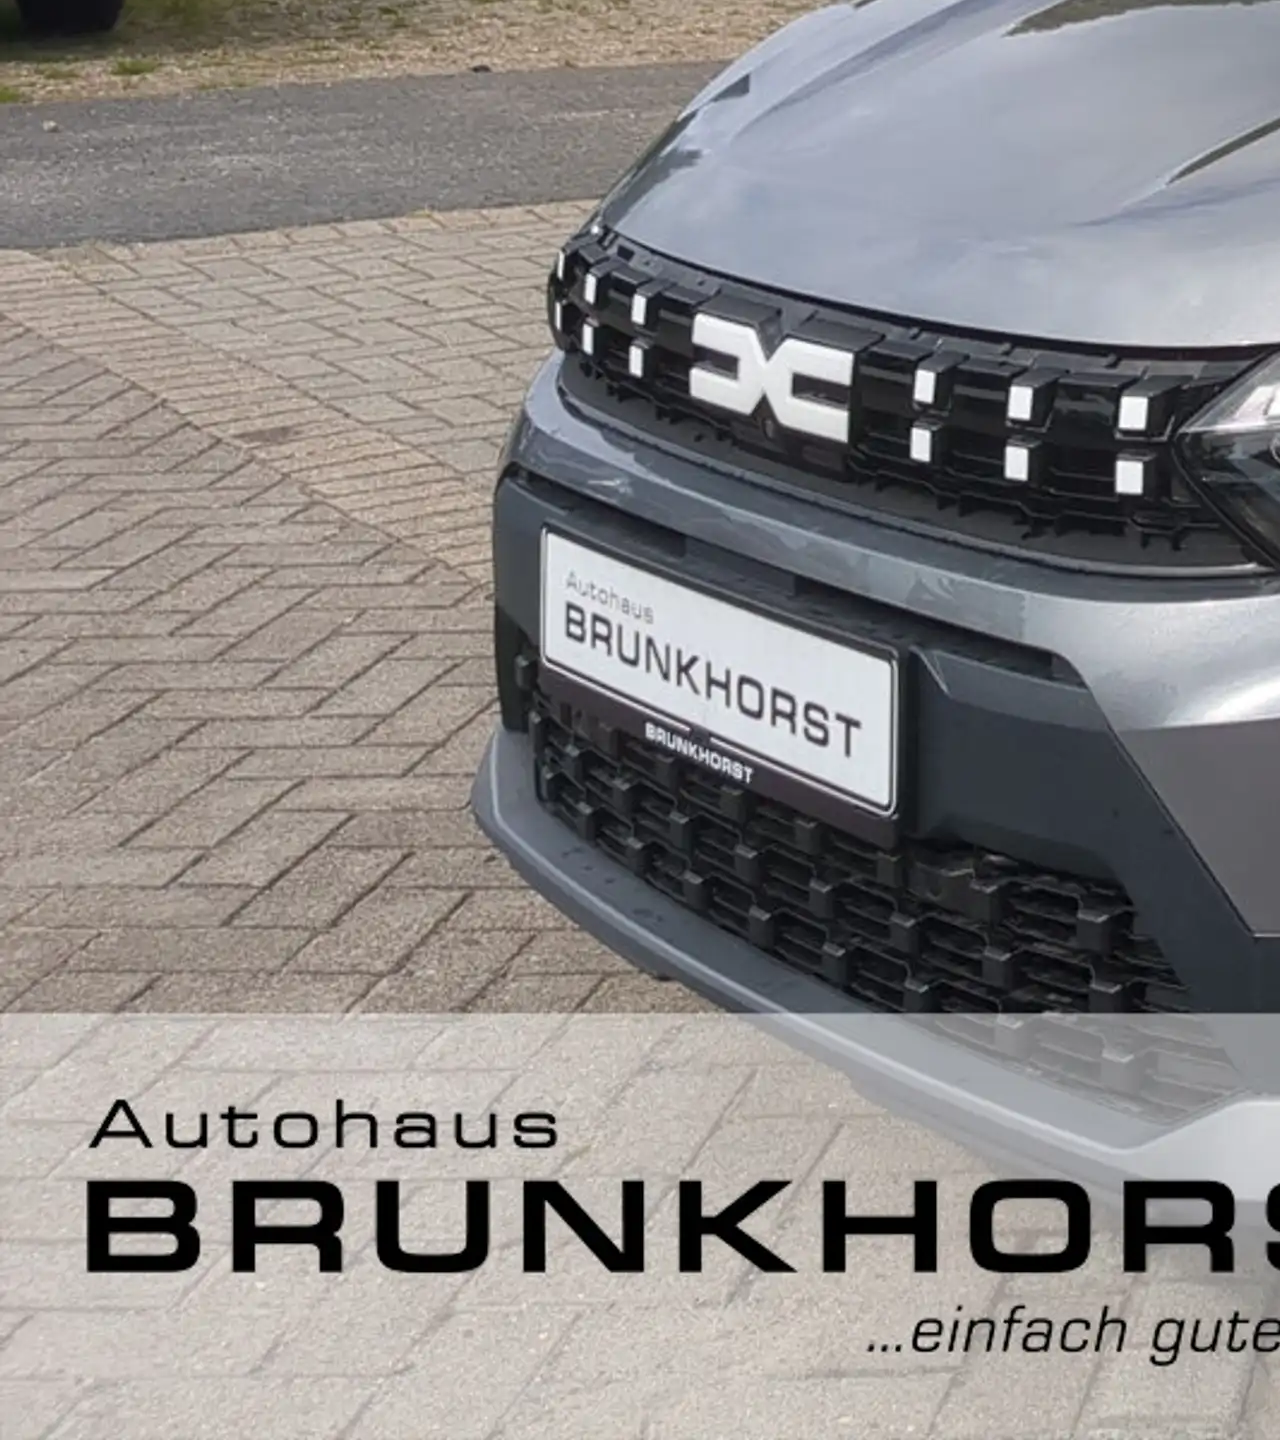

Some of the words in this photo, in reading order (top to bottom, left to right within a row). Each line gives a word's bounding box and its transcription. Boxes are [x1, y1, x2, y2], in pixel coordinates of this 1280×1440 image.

[566, 570, 654, 625] Autohaus
[565, 601, 861, 758] BRUNKHORST
[645, 722, 754, 784] BRUNKHORST
